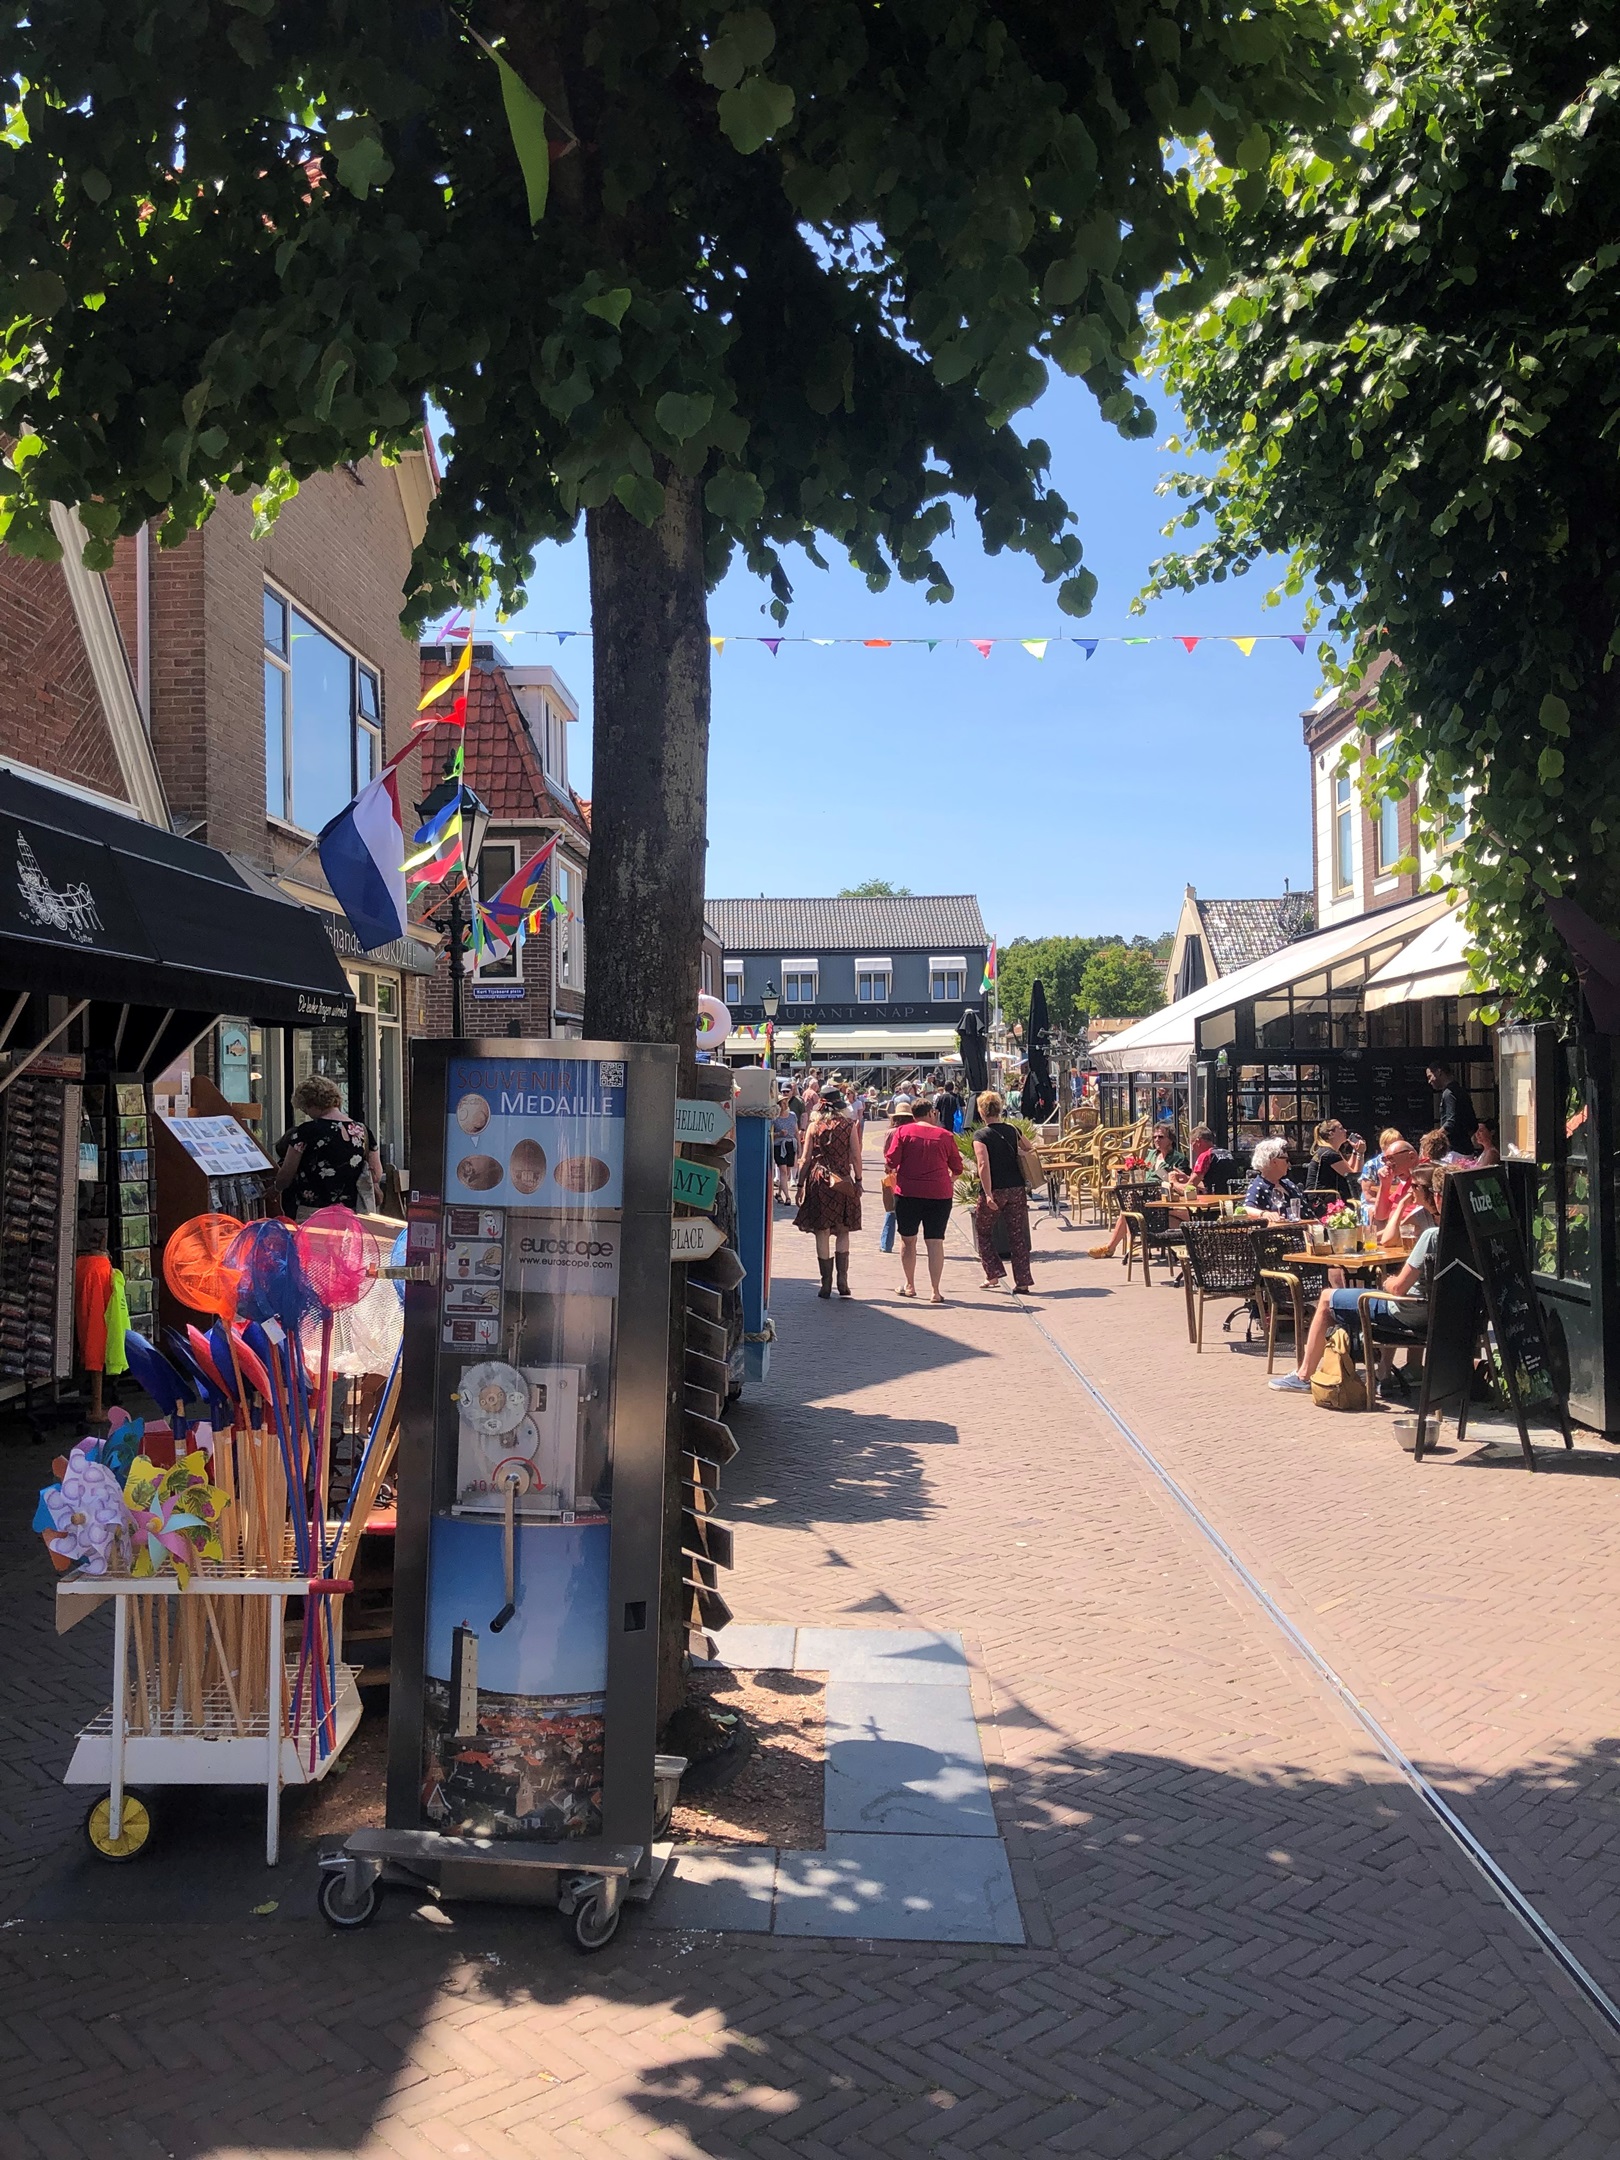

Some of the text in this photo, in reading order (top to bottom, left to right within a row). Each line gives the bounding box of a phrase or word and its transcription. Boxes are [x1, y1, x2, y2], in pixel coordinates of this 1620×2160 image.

[298, 994, 307, 1013] De
[731, 1007, 914, 1019] ESTURANT NAP
[457, 1066, 573, 1092] SOUVENIR
[501, 1091, 613, 1116] MEDAILLE
[674, 1168, 710, 1197] MY
[520, 1237, 614, 1260] euroscope
[671, 1227, 704, 1251] PLACE
[519, 1257, 613, 1269] www.euroscope.com
